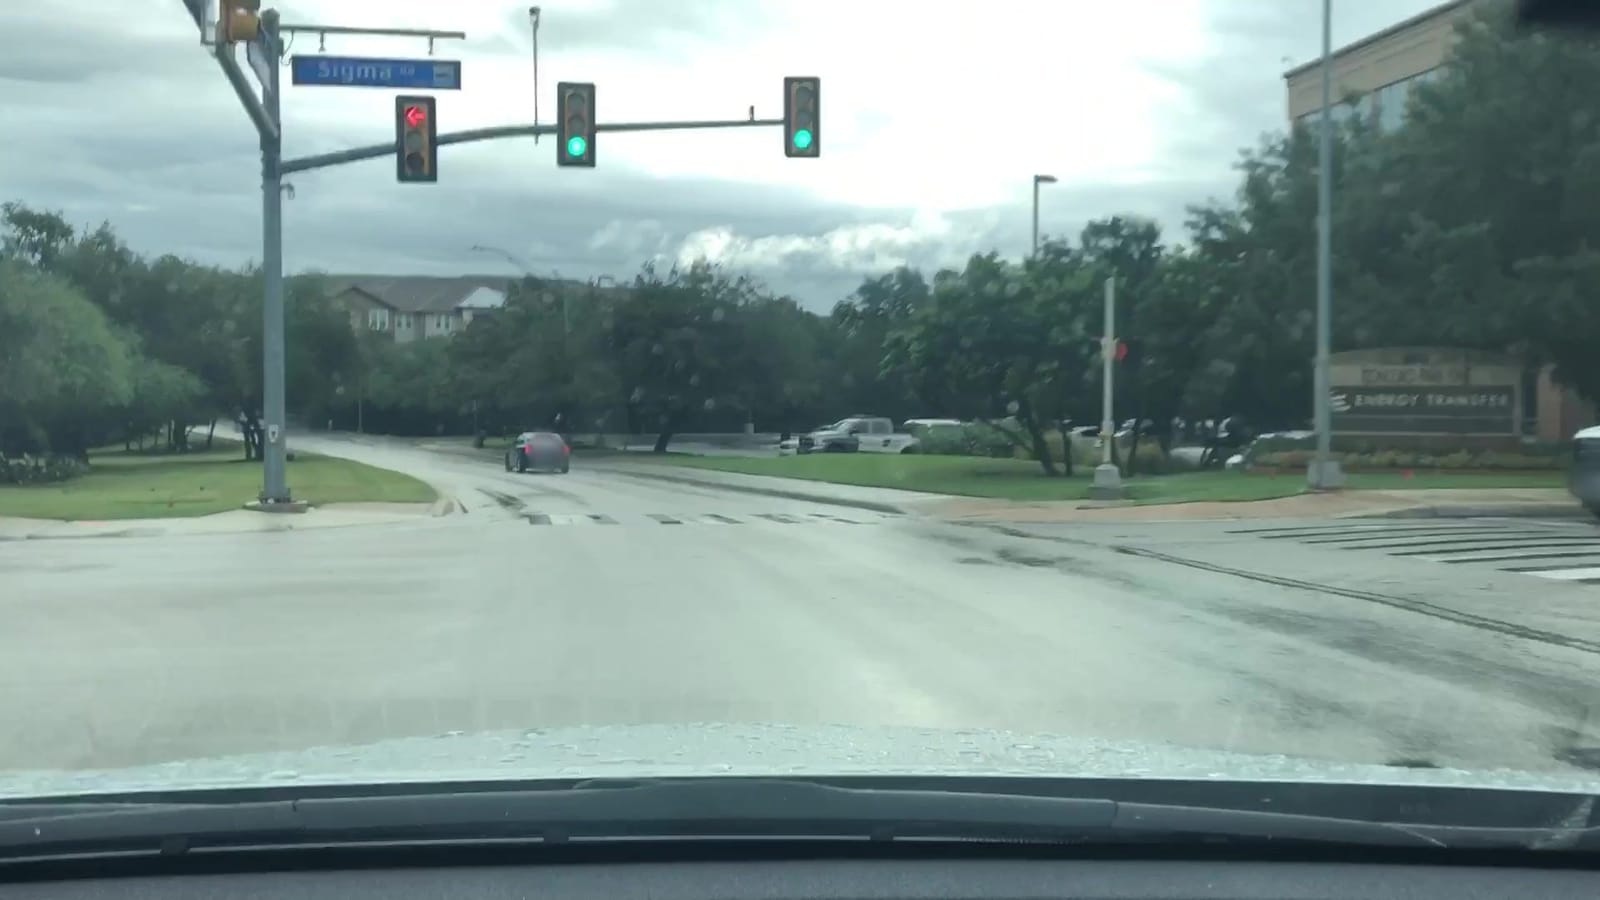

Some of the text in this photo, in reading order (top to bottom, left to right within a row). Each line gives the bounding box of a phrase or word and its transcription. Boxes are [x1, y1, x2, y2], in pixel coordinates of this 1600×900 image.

[317, 61, 391, 83] Sigma
[1354, 394, 1508, 407] ENERGY TRANSFER
